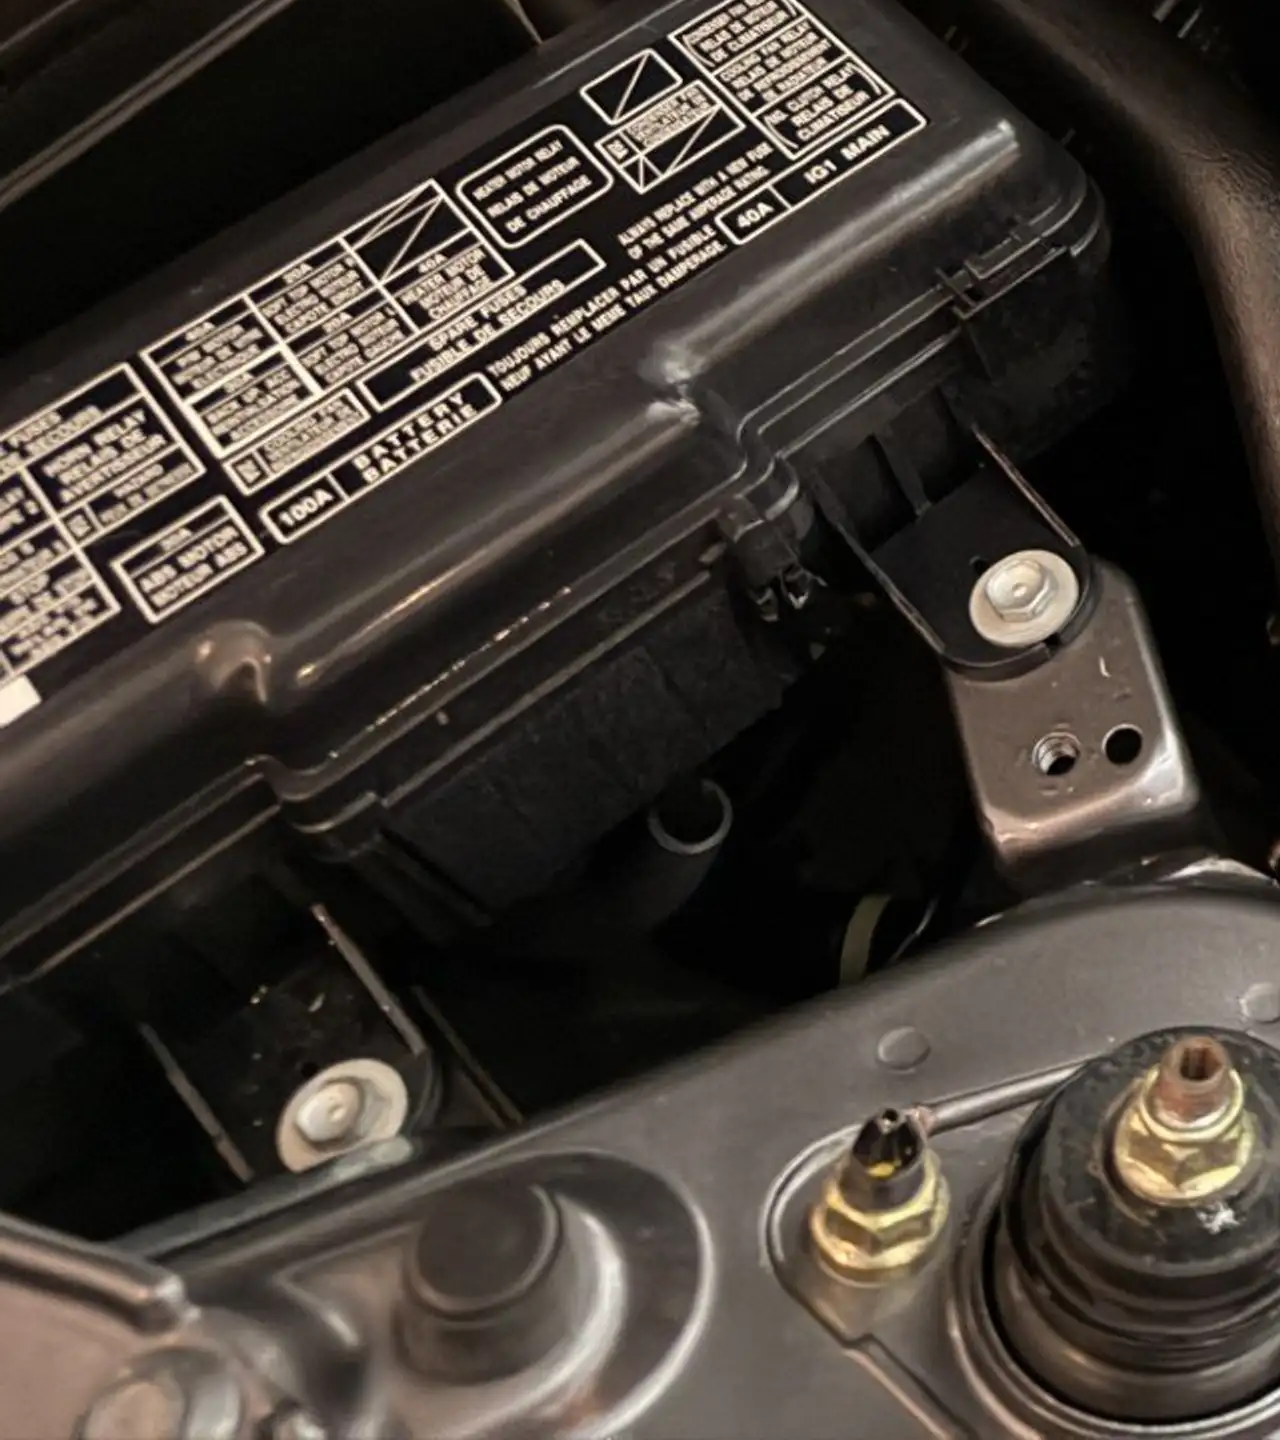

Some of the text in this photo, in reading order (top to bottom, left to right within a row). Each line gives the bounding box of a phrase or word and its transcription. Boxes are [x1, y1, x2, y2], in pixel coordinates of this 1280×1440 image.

[700, 29, 731, 52] RELAIS
[729, 20, 744, 34] DE
[710, 47, 728, 63] DE
[720, 20, 811, 82] COOLING FAN RELAY
[731, 31, 818, 90] RELAIS DE MOTEUR
[738, 87, 754, 102] DE
[785, 84, 824, 113] CLUTCH
[822, 64, 855, 90] RELAY
[790, 83, 853, 128] RELAIS DE
[796, 90, 870, 141] CLIMATISEUR
[533, 138, 564, 162] RELAY
[735, 122, 890, 229] 40A IG1 MAIN
[487, 154, 580, 218] RELAIS DE MOTEUR
[505, 173, 592, 234] DE CHAUFFAGE
[617, 141, 773, 246] ALWAYS REPLACE WITH A NEW FUSE
[416, 251, 447, 274] 40A
[627, 244, 644, 260] OF
[642, 232, 663, 250] THE
[661, 215, 689, 237] SAME
[309, 263, 344, 289] MOTOR
[400, 247, 486, 305] HEATER MOTOR
[419, 264, 484, 309] MOTEUR DE
[428, 275, 492, 320] CHAUFFAGE
[486, 223, 716, 378] TOUJOURS REMPLACER PAR UN FUSIBLE
[285, 302, 329, 334] CAPOTE
[350, 311, 385, 338] MOTOR
[409, 277, 565, 382] FUSIBLE DE SECOURS
[429, 284, 527, 350] SPARE FUSES
[499, 363, 534, 391] NEUF
[532, 338, 573, 370] AYANT
[572, 326, 592, 343] LE
[590, 303, 626, 332] MEME
[624, 282, 657, 309] TAUX
[8, 409, 60, 448] FUSES
[42, 407, 148, 479] HORN RELAY
[58, 427, 145, 487] RELAIS DE
[352, 392, 466, 470] BATTERY
[361, 403, 477, 482] BATTERIE
[58, 430, 165, 505] AVERTISSEUR
[278, 485, 333, 527] 100A
[138, 524, 238, 593] ABS MOTOR
[150, 540, 247, 608] MOTEUR ABS
